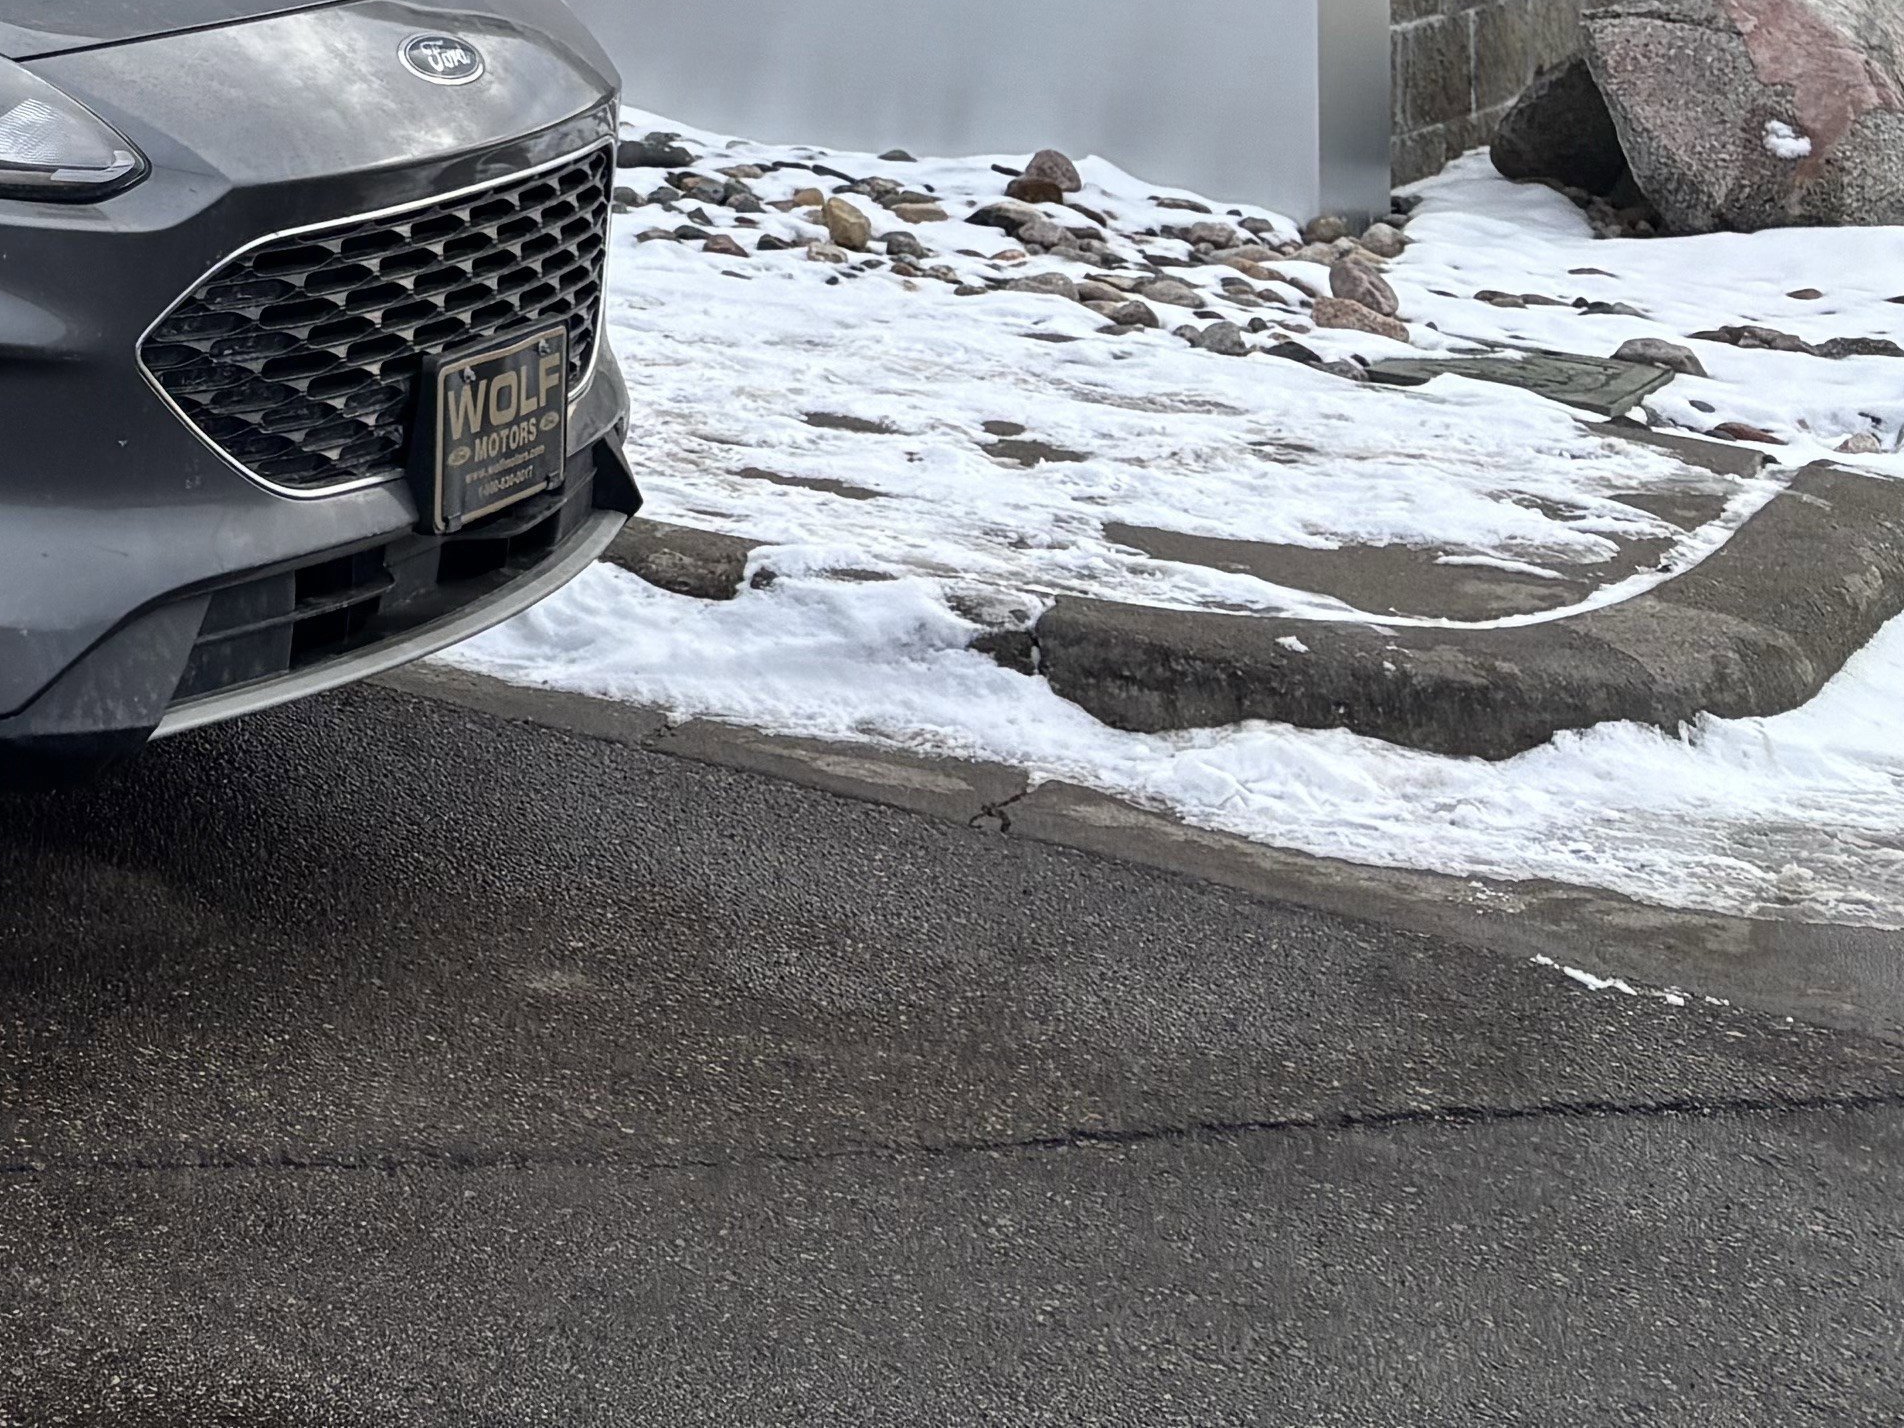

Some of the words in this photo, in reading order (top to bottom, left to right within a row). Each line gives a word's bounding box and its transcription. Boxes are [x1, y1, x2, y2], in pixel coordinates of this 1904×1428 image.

[419, 39, 472, 72] Ford
[447, 351, 561, 441] WOLF
[473, 416, 538, 463] MOTORS
